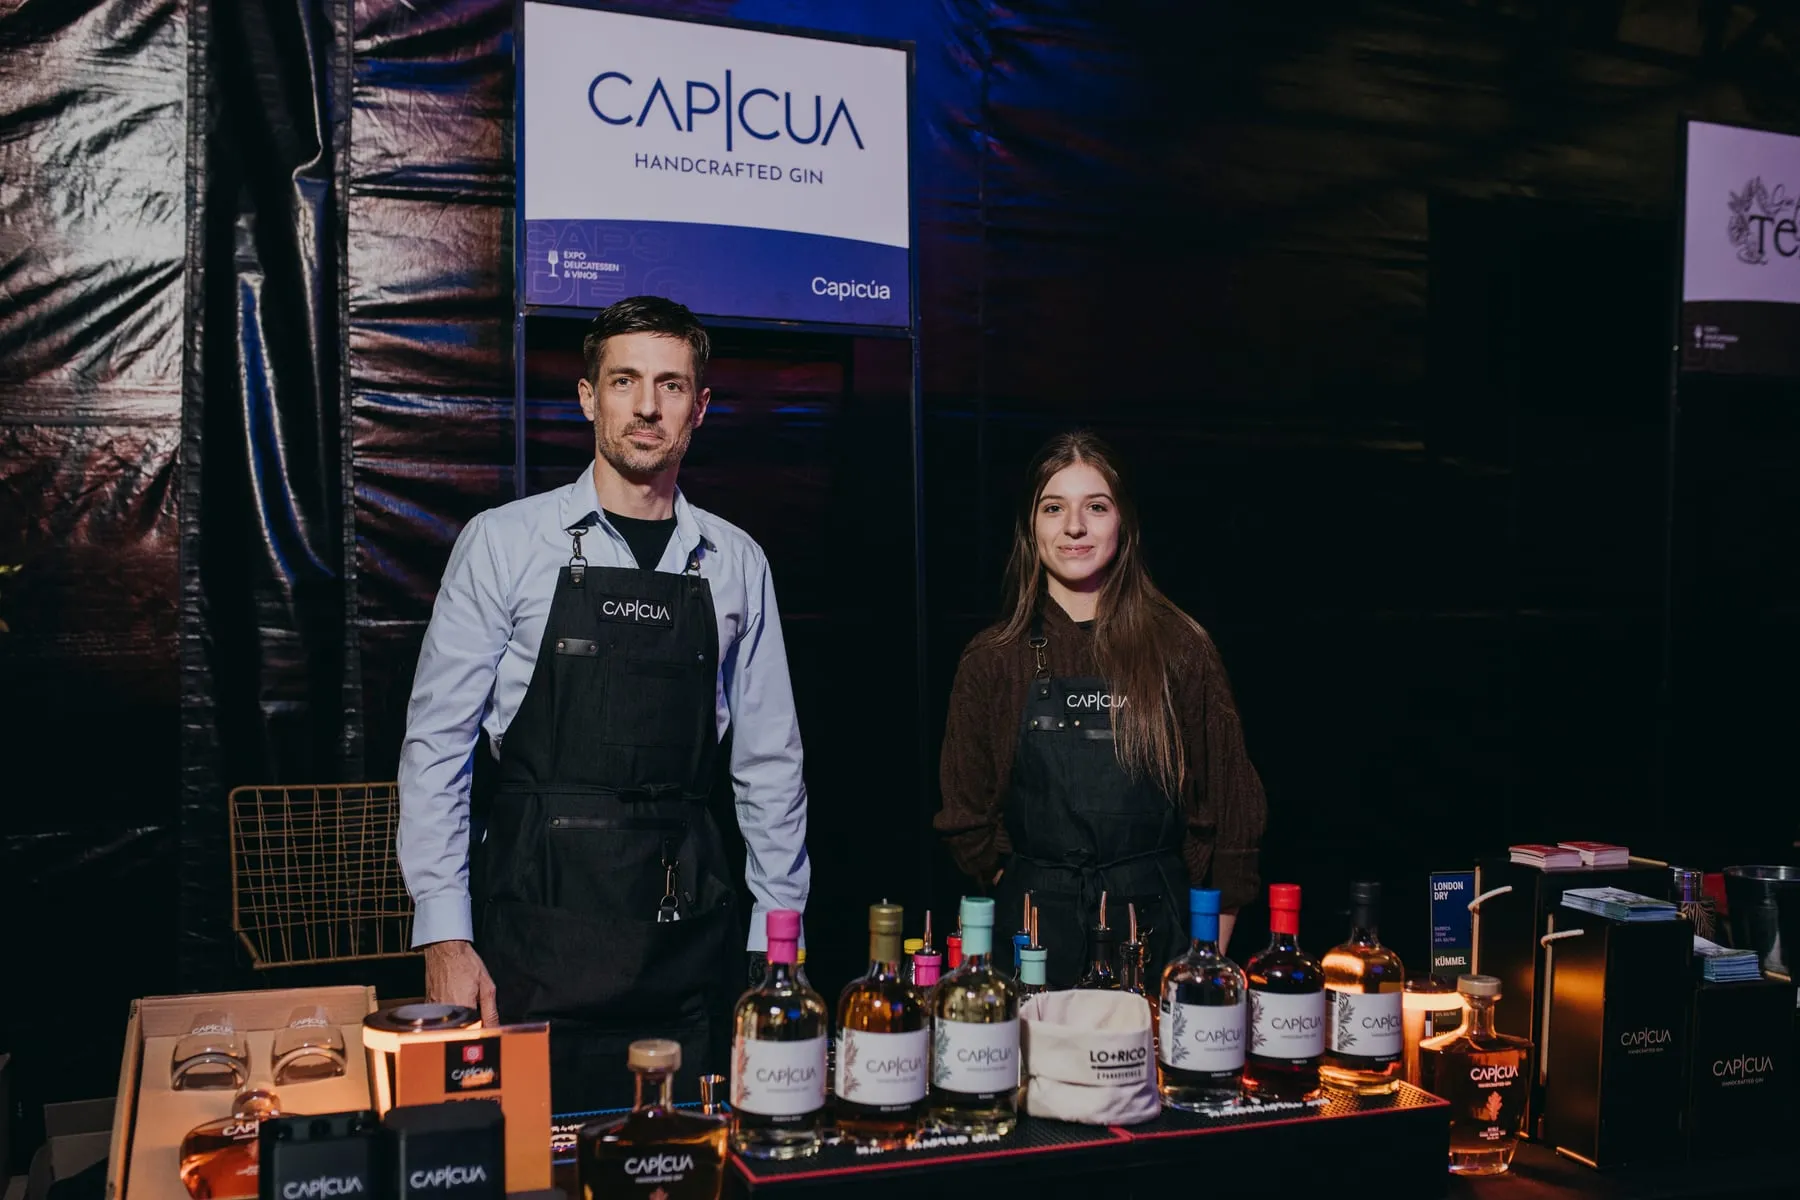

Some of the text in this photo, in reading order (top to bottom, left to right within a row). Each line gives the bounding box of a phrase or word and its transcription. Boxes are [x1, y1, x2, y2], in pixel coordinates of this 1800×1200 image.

[635, 152, 824, 185] HANDCRAFTED GIN
[1748, 214, 1800, 257] Te
[563, 250, 587, 260] EXPO
[563, 260, 620, 272] DELICATESSEN
[563, 270, 598, 280] & VINOS
[812, 276, 892, 302] Capicúa
[1433, 881, 1465, 891] LONDON
[1434, 891, 1449, 901] DRY
[1434, 955, 1467, 967] KÜMMEL
[1362, 1012, 1401, 1031] CAPICU
[1089, 1046, 1147, 1063] LO+RICO
[222, 1120, 260, 1137] CAPI
